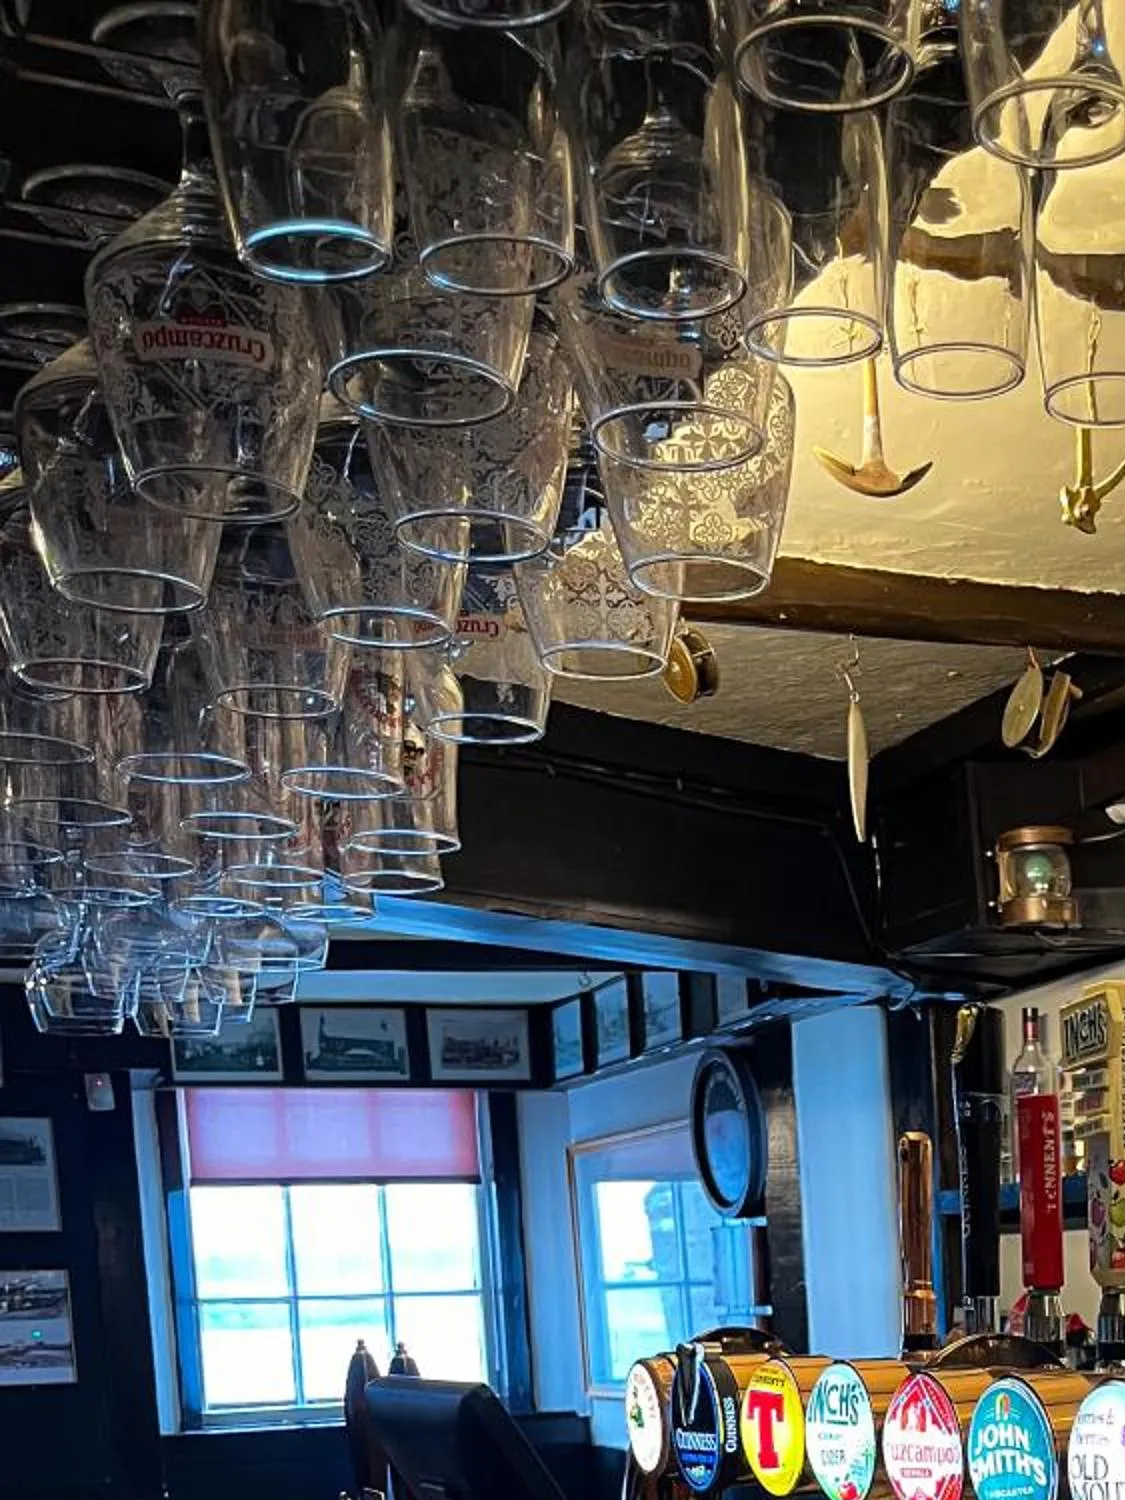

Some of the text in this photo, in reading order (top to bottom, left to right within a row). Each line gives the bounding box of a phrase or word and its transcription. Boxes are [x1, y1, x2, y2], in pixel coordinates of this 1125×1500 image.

[676, 1428, 718, 1451] GUINNESS
[747, 1389, 785, 1469] T
[974, 1423, 1031, 1456] JOHN
[1071, 1453, 1109, 1481] OLD
